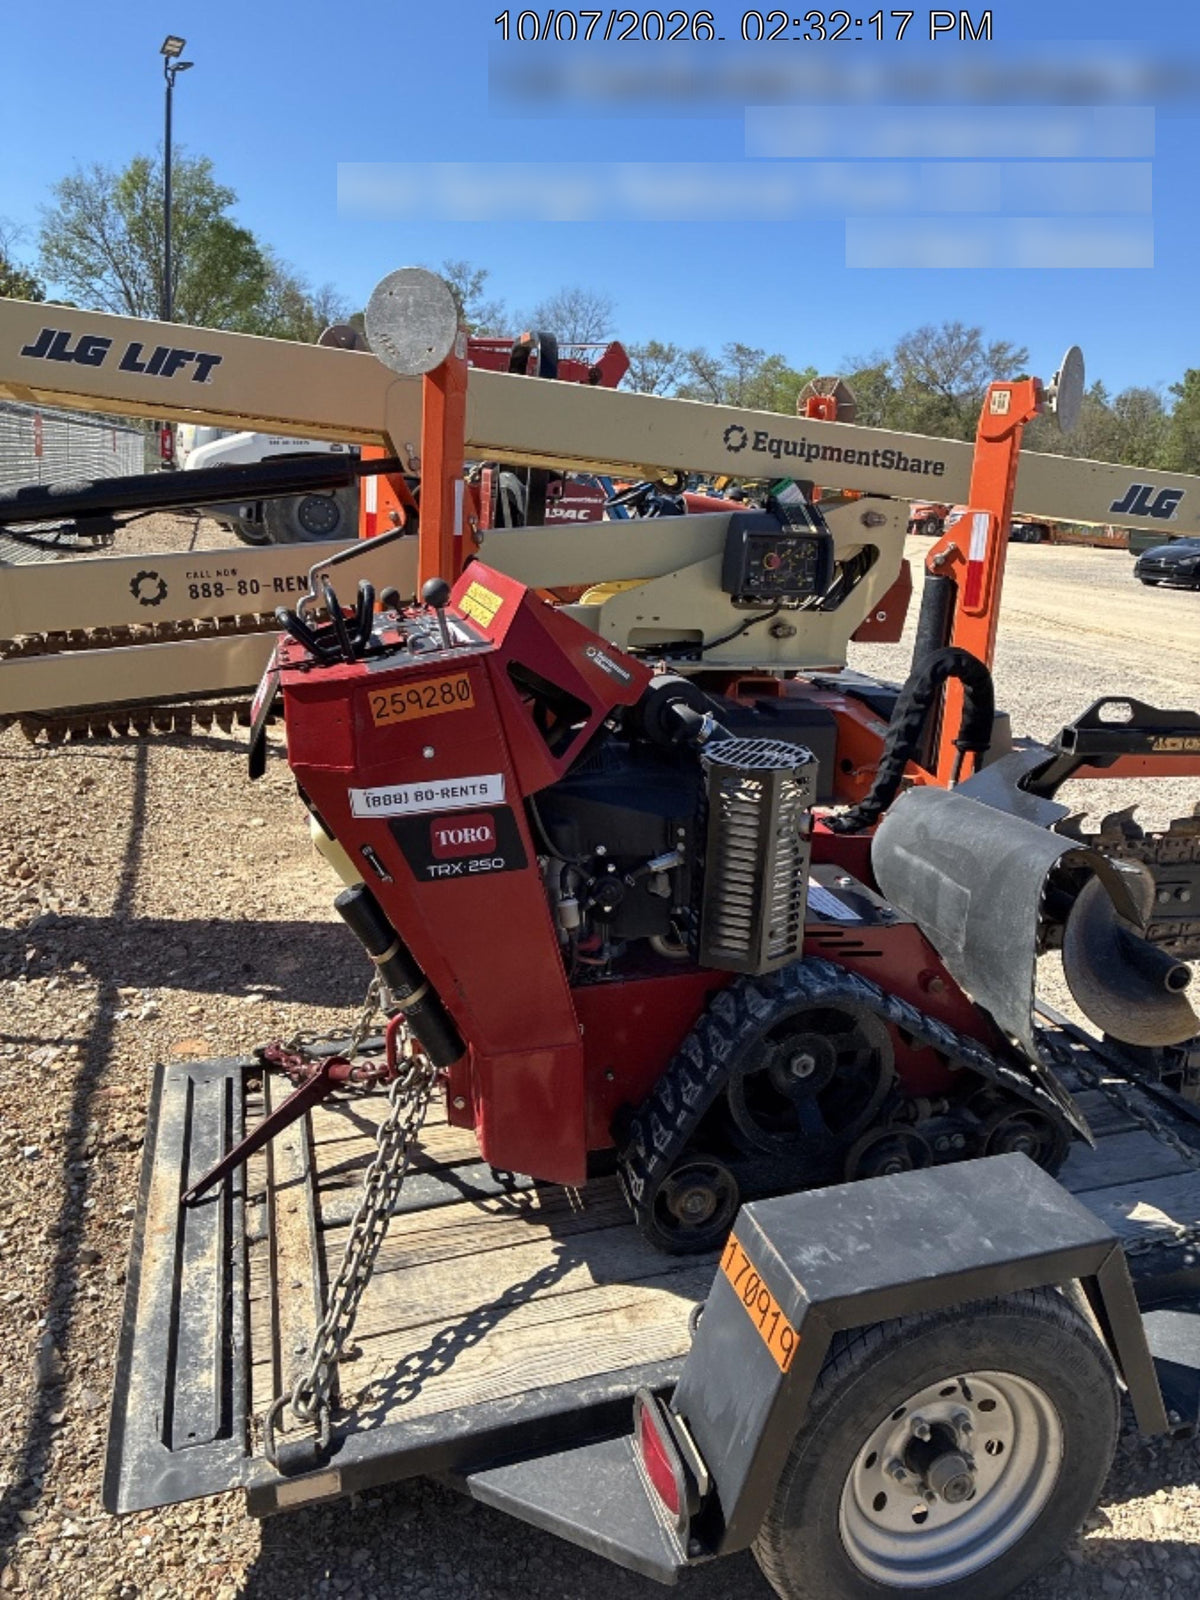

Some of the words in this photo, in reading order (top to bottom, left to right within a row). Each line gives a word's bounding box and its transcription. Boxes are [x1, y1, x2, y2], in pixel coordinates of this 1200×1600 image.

[20, 328, 113, 367] JLG
[119, 342, 223, 383] LIFT
[752, 431, 945, 476] EquipmentShare
[1108, 483, 1186, 520] JLG
[188, 574, 330, 600] 888-80-REN
[373, 679, 470, 719] 259280
[366, 791, 409, 808] (888)
[414, 783, 489, 803] 80-RENTS
[435, 826, 492, 847] TORO
[724, 1241, 795, 1369] 170919
